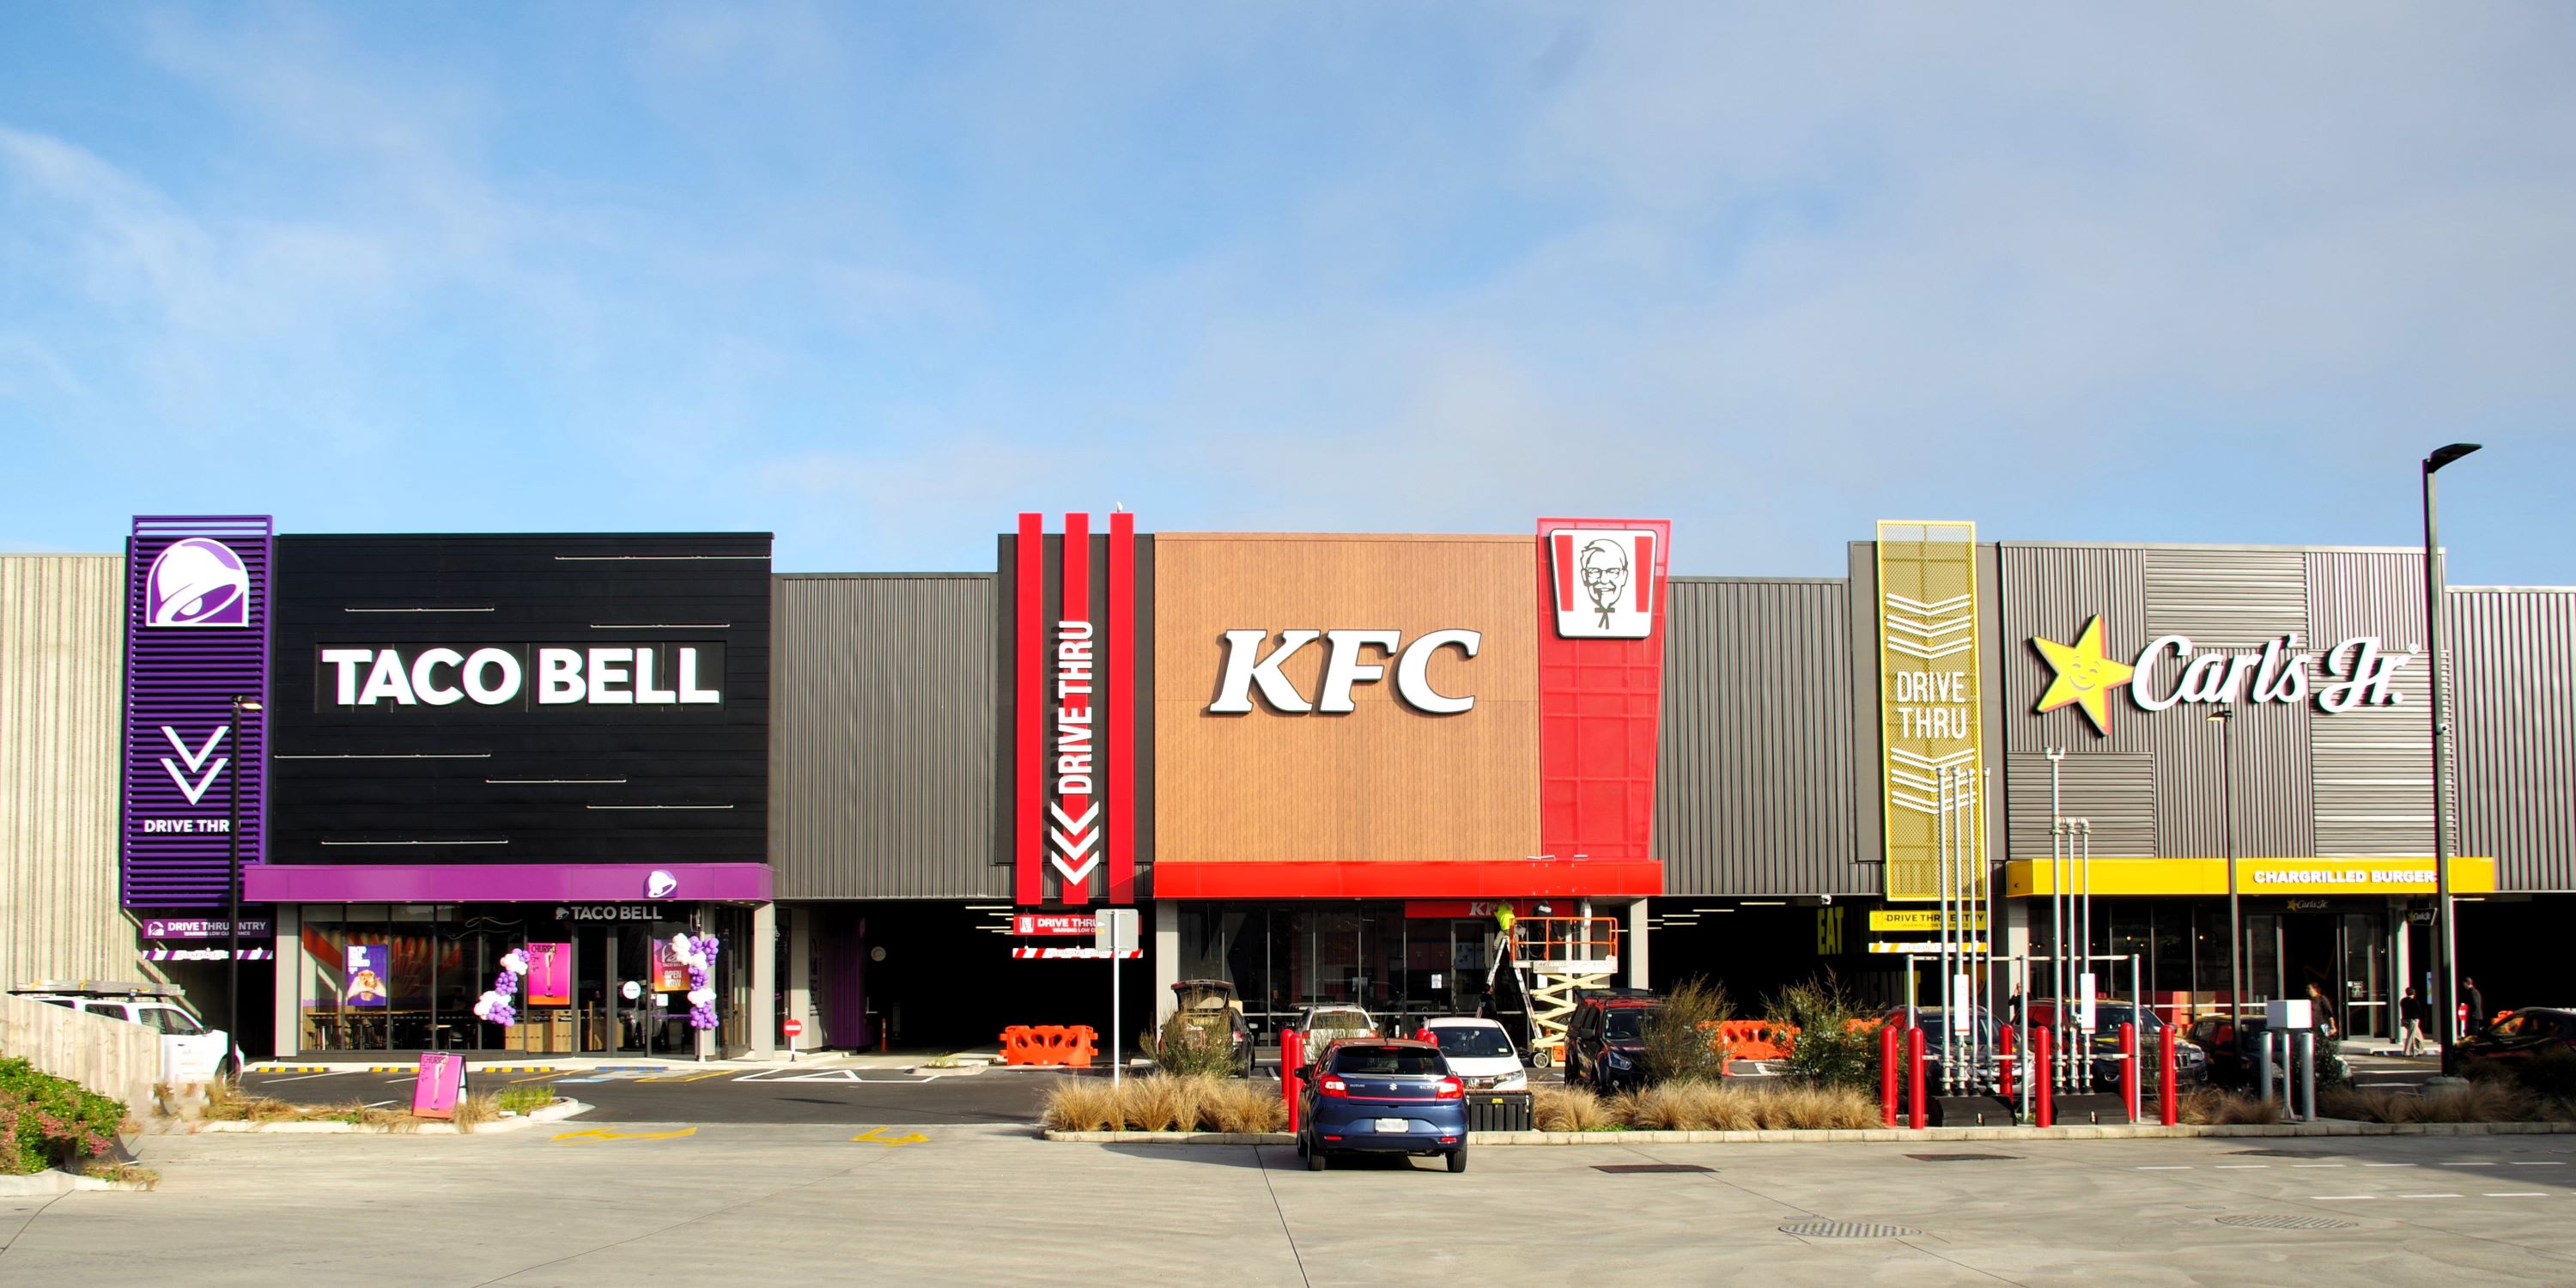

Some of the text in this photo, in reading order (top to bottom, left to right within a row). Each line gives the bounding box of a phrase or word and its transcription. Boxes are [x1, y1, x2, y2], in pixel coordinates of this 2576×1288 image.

[321, 647, 720, 706] TACO BELL
[1208, 628, 1482, 714] KFC
[2131, 632, 2314, 713] Carl's
[1896, 671, 1965, 703] DRIVE
[1058, 620, 1093, 794] DRIVE THRU
[1897, 707, 1967, 740] THRU
[143, 819, 242, 833] DRIVE THR
[2253, 870, 2366, 884] CHARGRILLED
[571, 906, 663, 920] TACO BELL
[1886, 914, 1984, 922] DRIVE THR ETY
[167, 921, 266, 932] DRIVE THRU NTRY
[1037, 918, 1069, 927] DRIVE
[1817, 906, 1844, 956] EAT
[664, 969, 682, 979] OPEN
[664, 978, 682, 988] NOW
